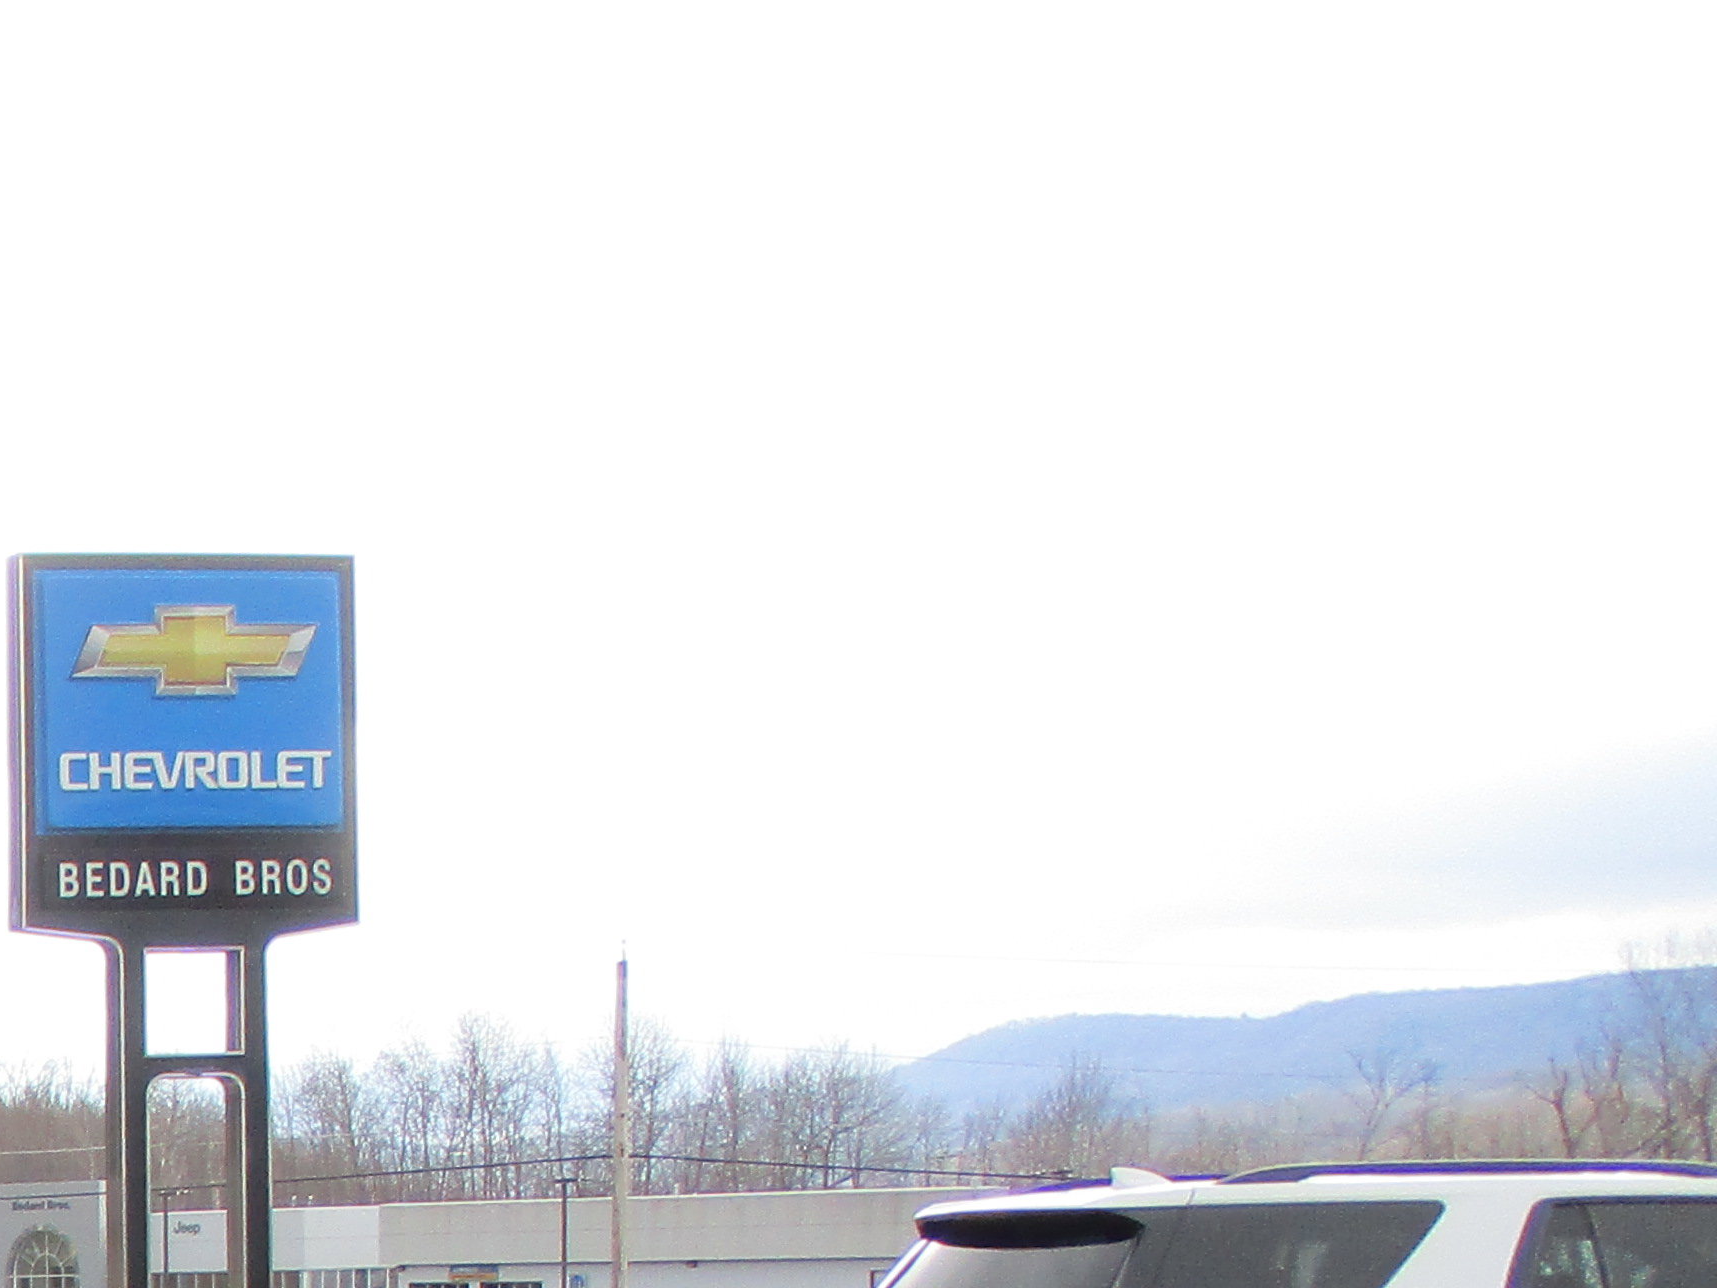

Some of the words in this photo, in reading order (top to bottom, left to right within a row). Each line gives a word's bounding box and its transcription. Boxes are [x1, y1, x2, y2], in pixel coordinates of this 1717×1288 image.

[59, 750, 332, 791] CHEVROLET
[58, 860, 208, 899] BEDARD
[235, 858, 334, 896] BROS
[173, 1220, 201, 1236] Jeep
